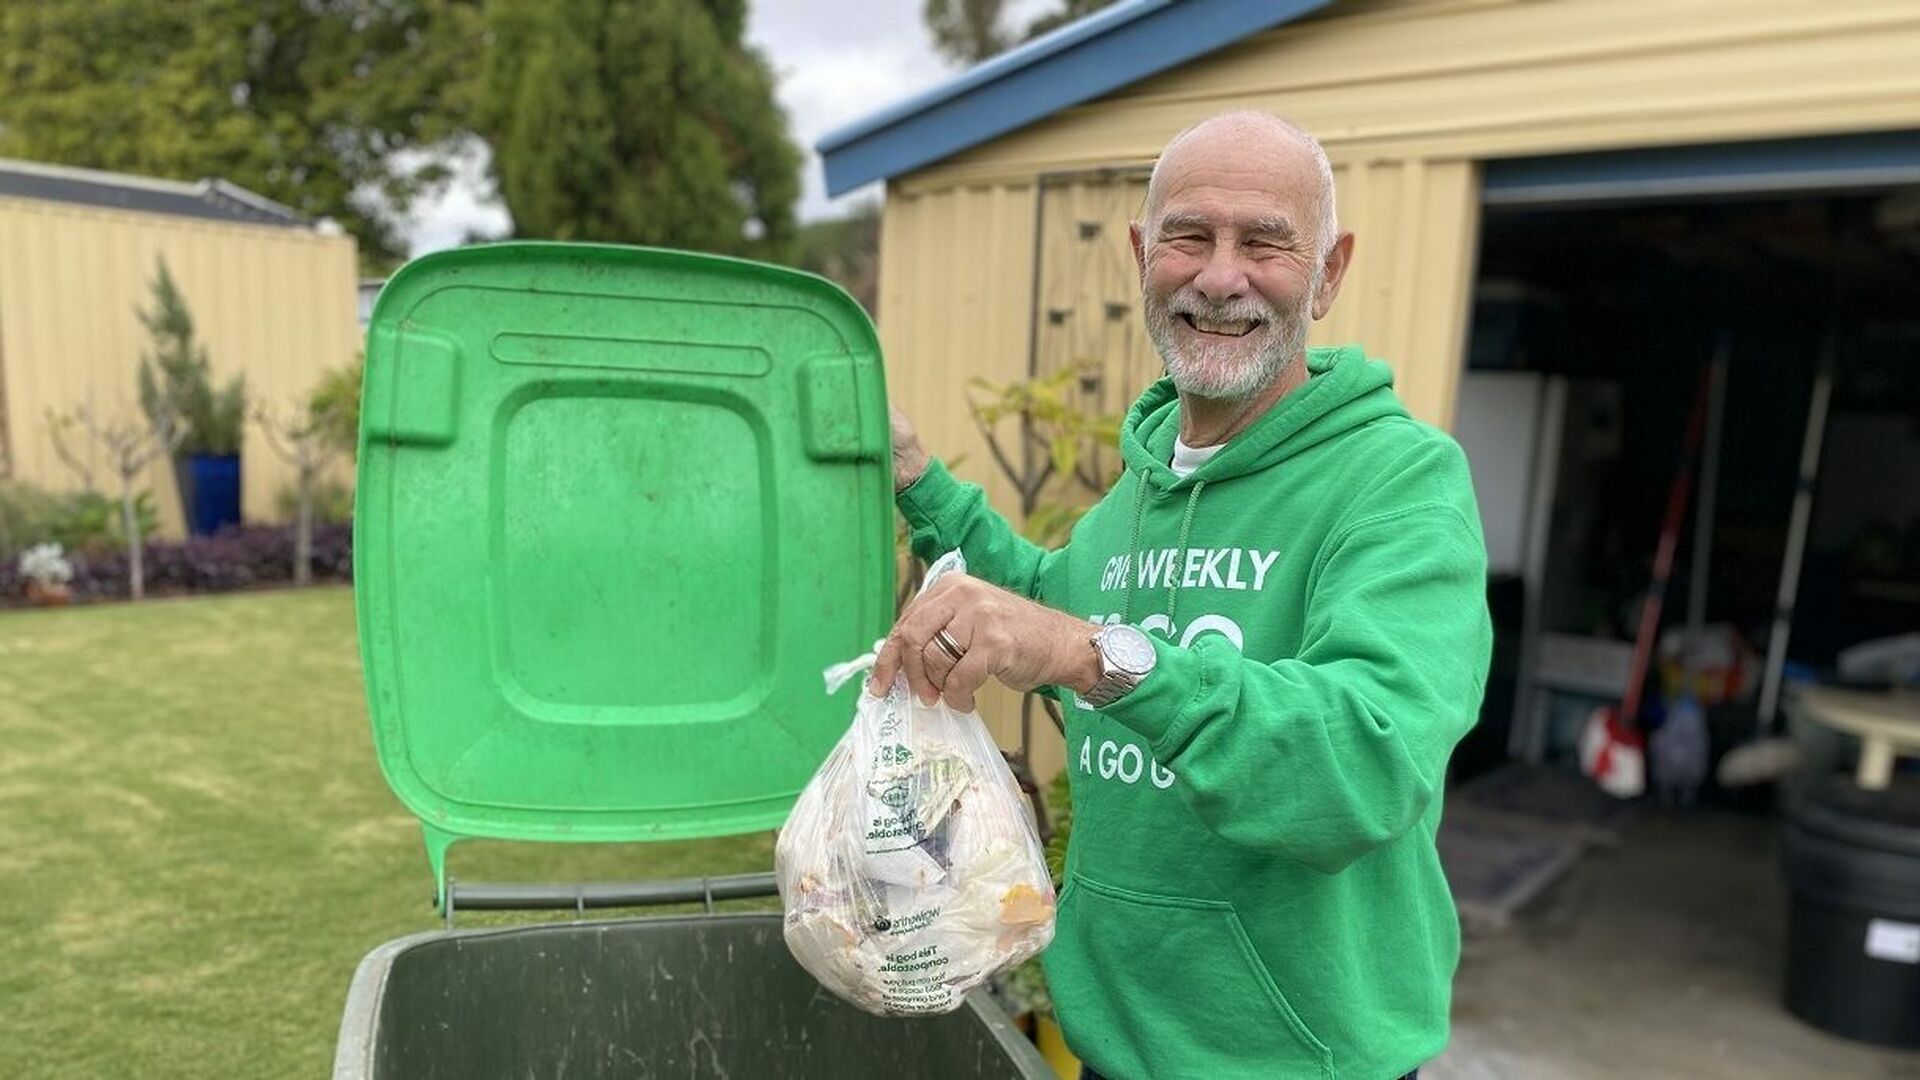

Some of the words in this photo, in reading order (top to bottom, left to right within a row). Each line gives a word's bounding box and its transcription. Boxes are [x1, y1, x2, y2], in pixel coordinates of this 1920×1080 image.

[1137, 547, 1280, 591] WEEKLY
[1079, 735, 1092, 774] A
[1098, 740, 1143, 784] GO
